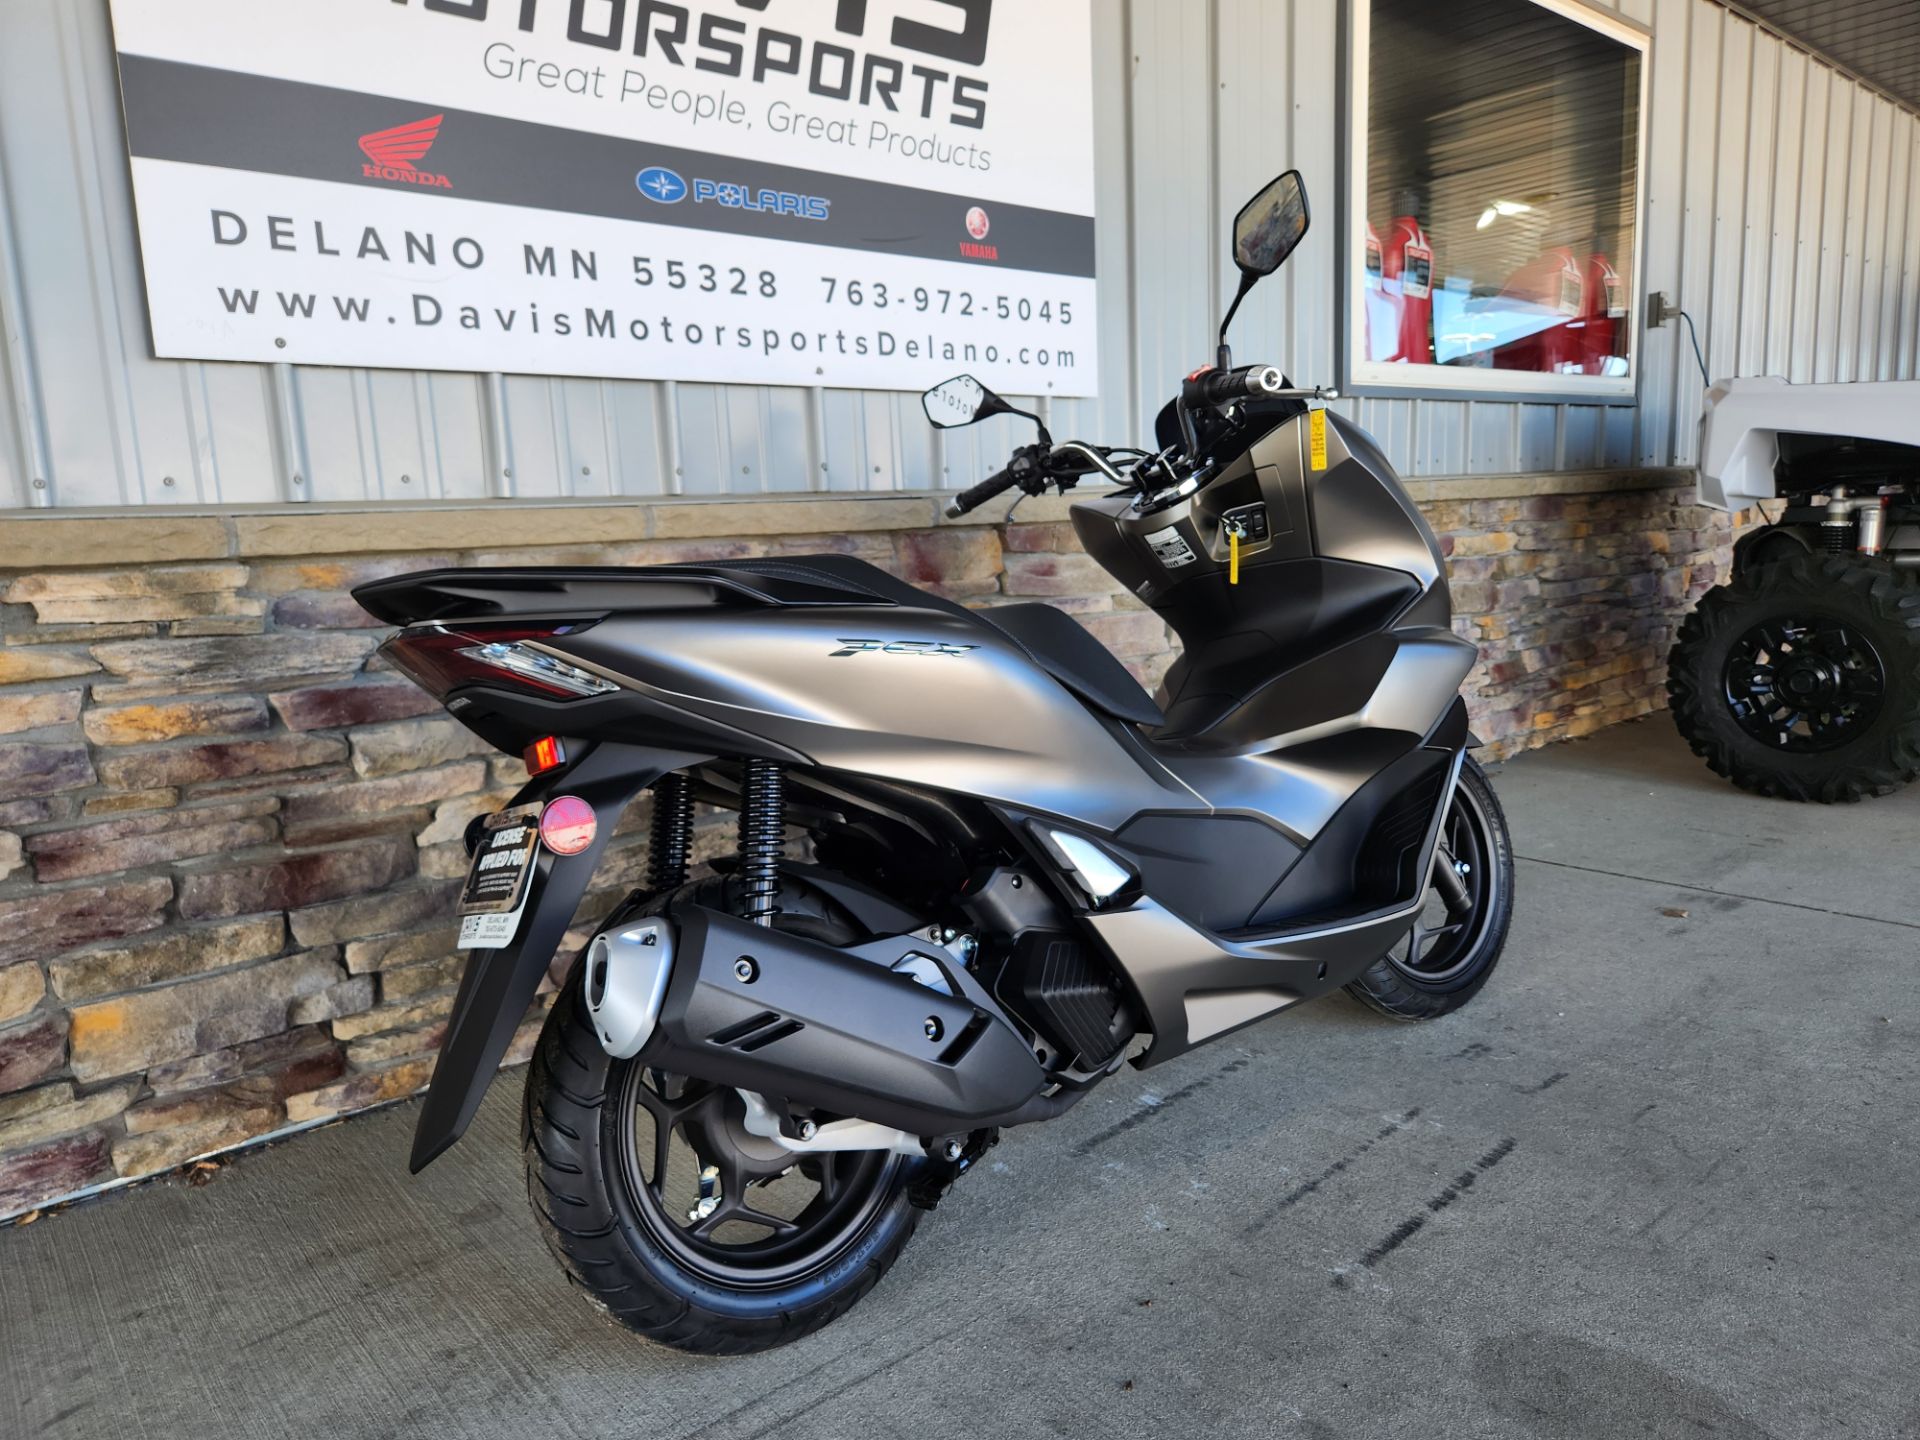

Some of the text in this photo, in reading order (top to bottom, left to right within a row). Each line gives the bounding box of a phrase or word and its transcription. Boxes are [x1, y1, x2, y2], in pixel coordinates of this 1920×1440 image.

[391, 0, 989, 130] ORSPORTS
[483, 42, 992, 171] Great People, Great Products
[362, 164, 453, 189] HONDA
[693, 178, 829, 221] POLARIS
[210, 208, 1073, 325] DELANO MN 55328 763-972-5045
[960, 241, 998, 260] YAMAHA
[217, 286, 1076, 368] www.DavisMotorsportsDelano.com
